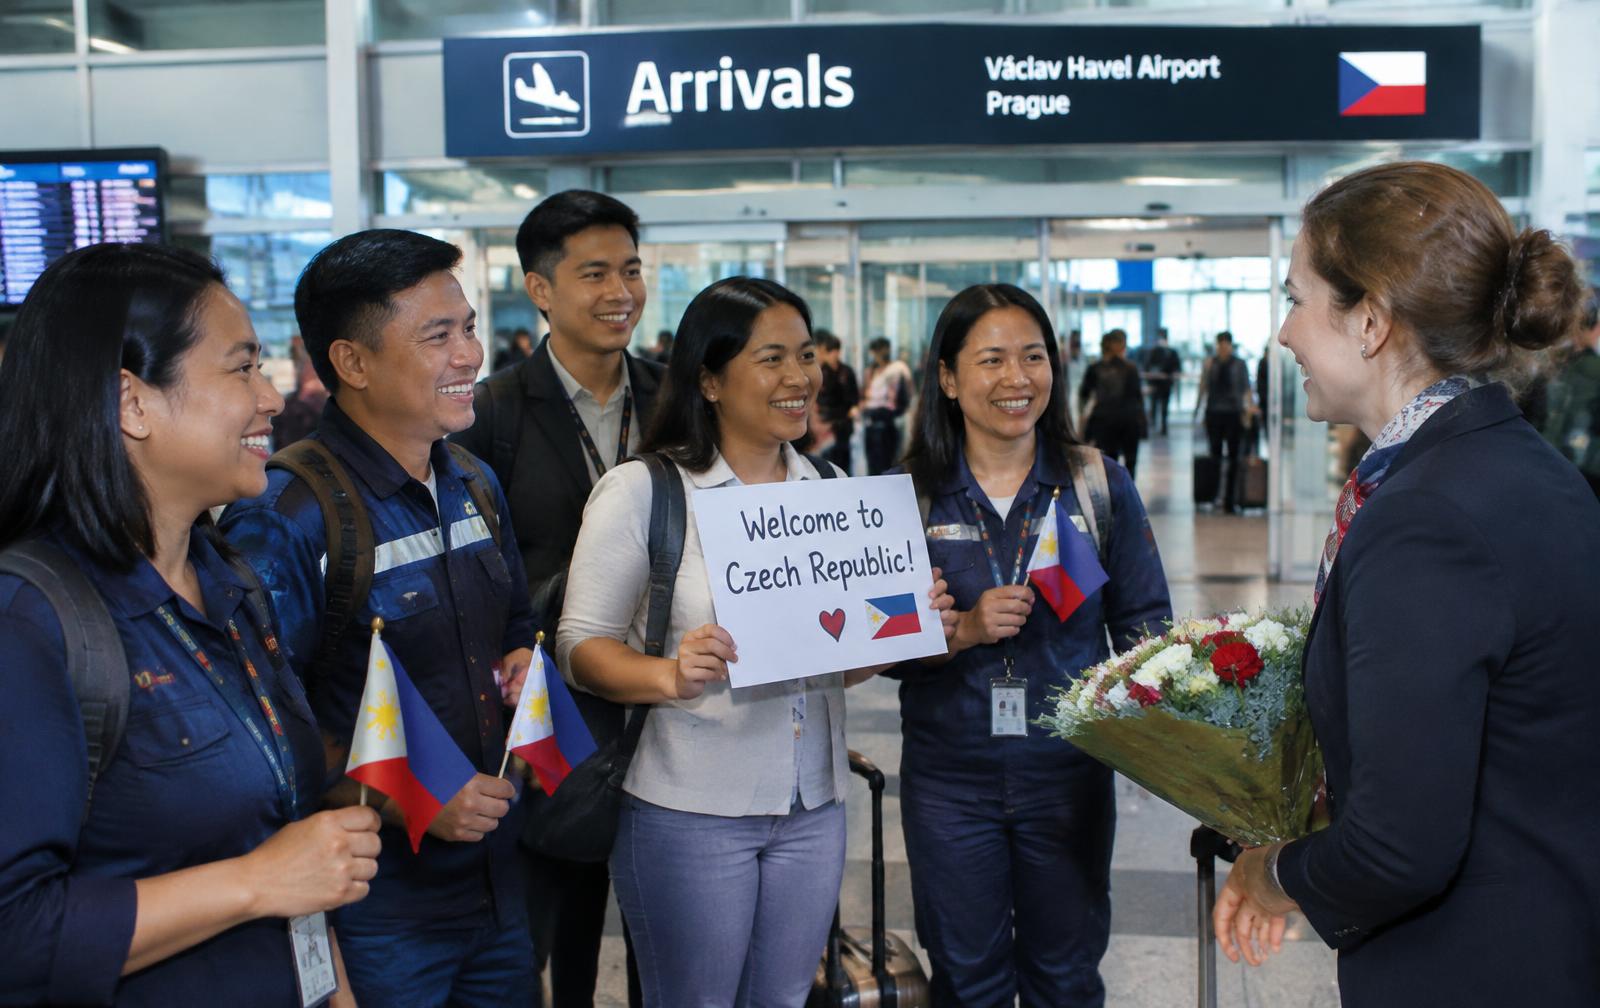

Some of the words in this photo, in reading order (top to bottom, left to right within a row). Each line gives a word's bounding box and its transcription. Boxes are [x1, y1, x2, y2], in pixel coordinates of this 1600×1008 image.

[625, 53, 855, 113] Arrivals
[984, 54, 1063, 81] Václav
[1067, 54, 1133, 80] Havel
[1137, 54, 1221, 84] Airport
[986, 90, 1071, 120] Prague
[740, 504, 849, 542] Welcome
[857, 499, 884, 529] to
[726, 556, 802, 595] Czech
[809, 539, 914, 591] Republic!
